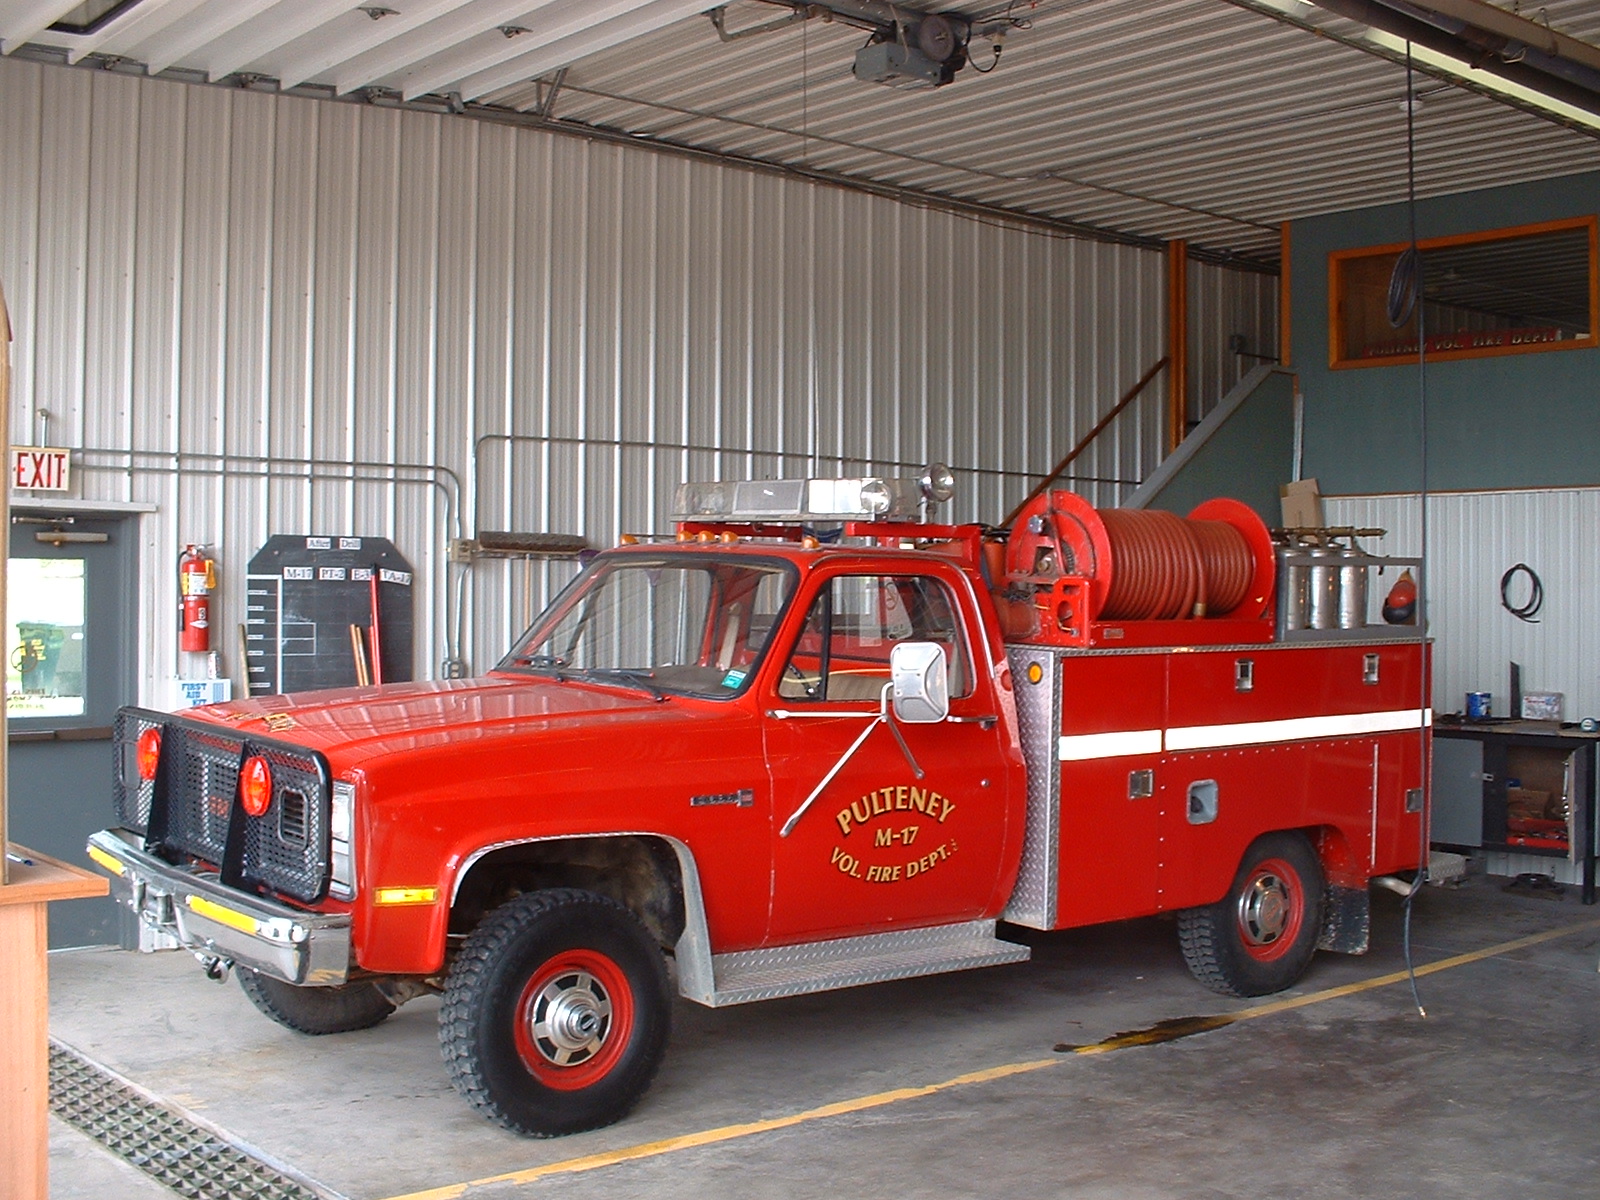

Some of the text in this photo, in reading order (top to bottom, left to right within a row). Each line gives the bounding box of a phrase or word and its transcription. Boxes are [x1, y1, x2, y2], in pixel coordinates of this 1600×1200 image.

[16, 452, 66, 488] EXIT
[286, 568, 313, 579] M-17
[321, 568, 345, 579] PT-2
[382, 570, 412, 584] TA-17
[181, 683, 207, 691] FIRST
[186, 691, 201, 699] AID
[836, 786, 955, 834] PULTENEY
[874, 826, 919, 847] M-17
[830, 843, 951, 882] VOL. FIRE DEPT.
